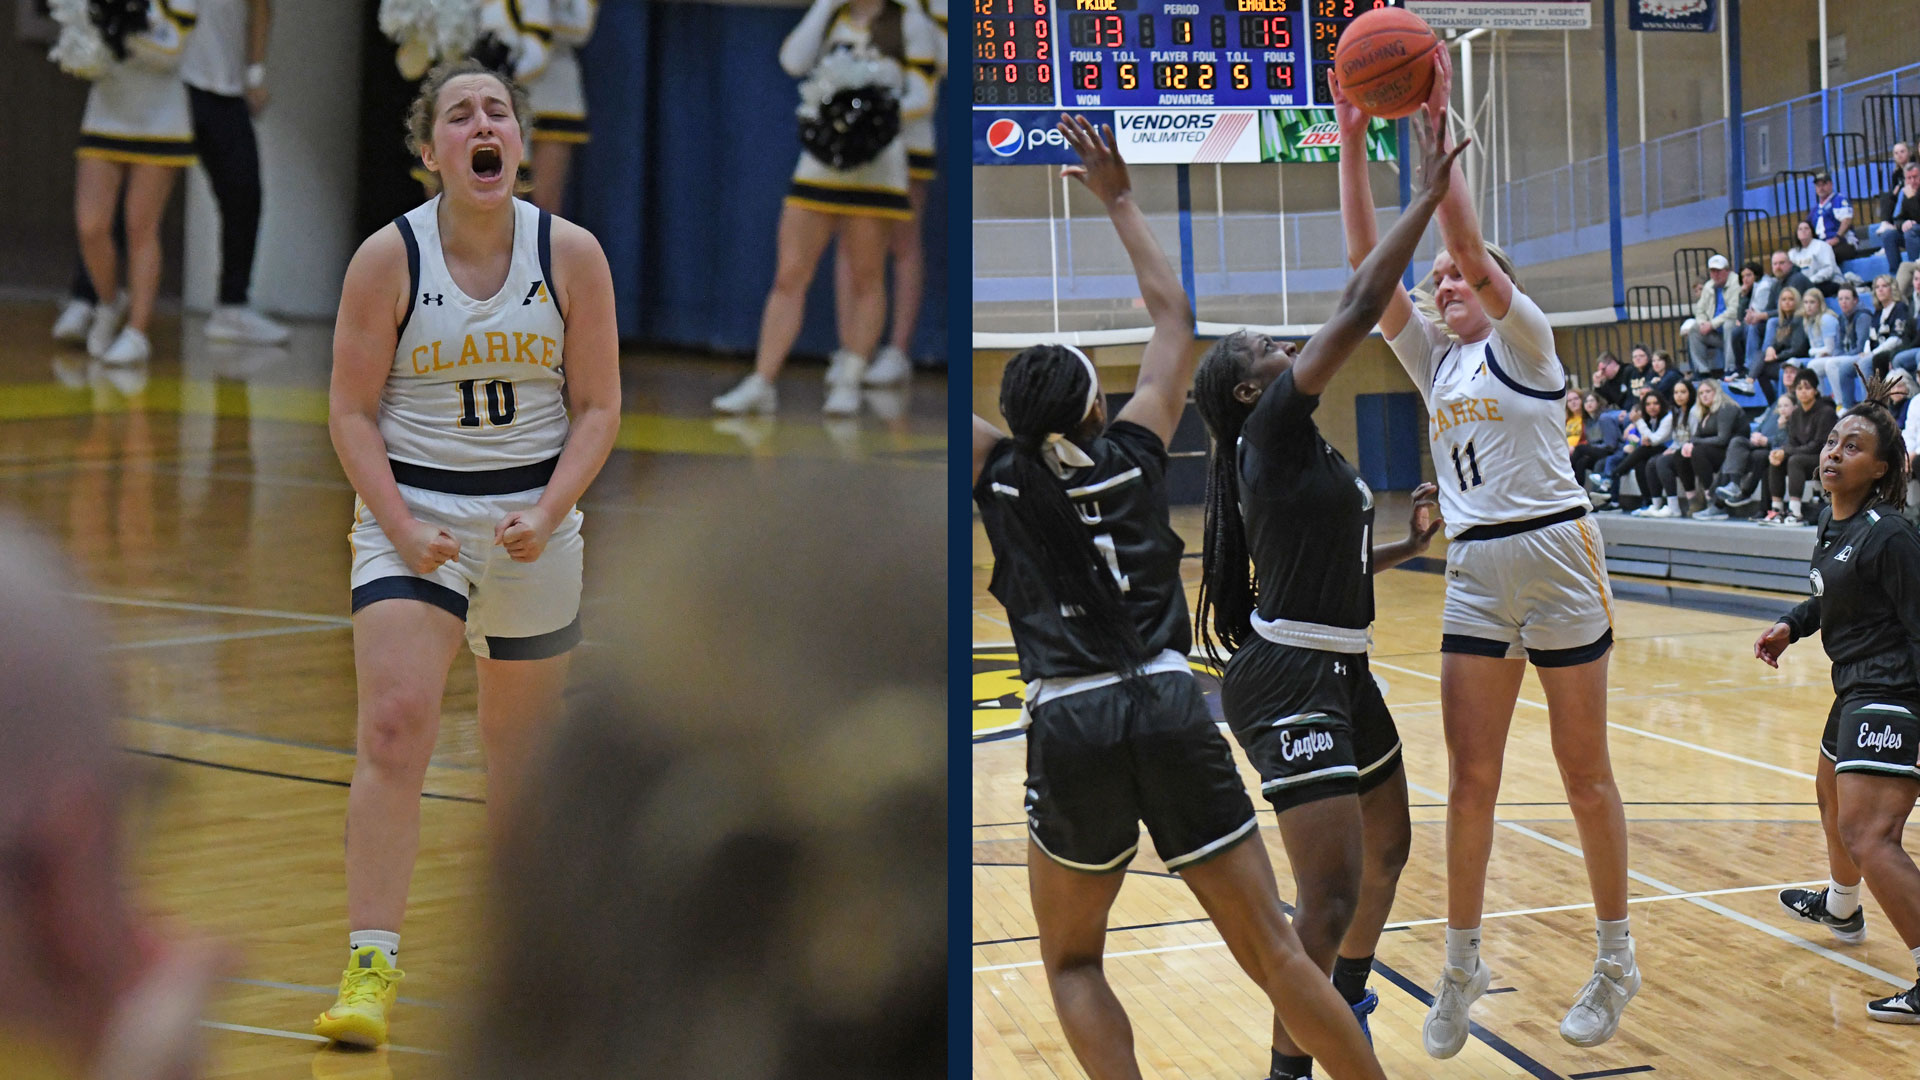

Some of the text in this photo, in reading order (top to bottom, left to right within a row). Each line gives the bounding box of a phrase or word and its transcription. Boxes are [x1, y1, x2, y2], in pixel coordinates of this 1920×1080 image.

[1076, 0, 1117, 10] PRIDE
[1164, 4, 1199, 15] PERIOD
[1238, 0, 1286, 11] EAGLES
[1319, 0, 1336, 17] 12
[1468, 8, 1538, 16] RESPONSIBILITY
[1548, 8, 1585, 16] RESPECT
[977, 19, 1048, 39] 15 1 0
[1094, 15, 1123, 48] 13
[1184, 21, 1191, 43] 1
[1263, 16, 1290, 48] 15
[1315, 22, 1337, 39] 34
[978, 40, 1049, 60] 10 0 2
[1070, 51, 1102, 62] FOULS
[1112, 51, 1140, 62] T.O.L.
[1150, 51, 1218, 62] PLAYER FOUL
[1225, 51, 1253, 62] T.O.L.
[1264, 52, 1295, 62] FOULS
[1005, 63, 1018, 83] 0
[1037, 63, 1050, 83] 0
[1083, 64, 1099, 89] 2
[1120, 64, 1136, 89] 5
[1233, 64, 1249, 89] 5
[1276, 66, 1291, 87] 4
[1076, 94, 1101, 105] WON
[1159, 94, 1215, 105] ADVANTAGE
[1269, 94, 1293, 105] WON
[1119, 114, 1216, 130] VENDORS
[1132, 131, 1206, 143] UNLIMITED
[412, 331, 557, 375] CLARKE
[456, 379, 517, 430] 10
[1450, 438, 1485, 494] 11
[1280, 729, 1333, 761] Eagles
[1857, 722, 1902, 753] Eagles
